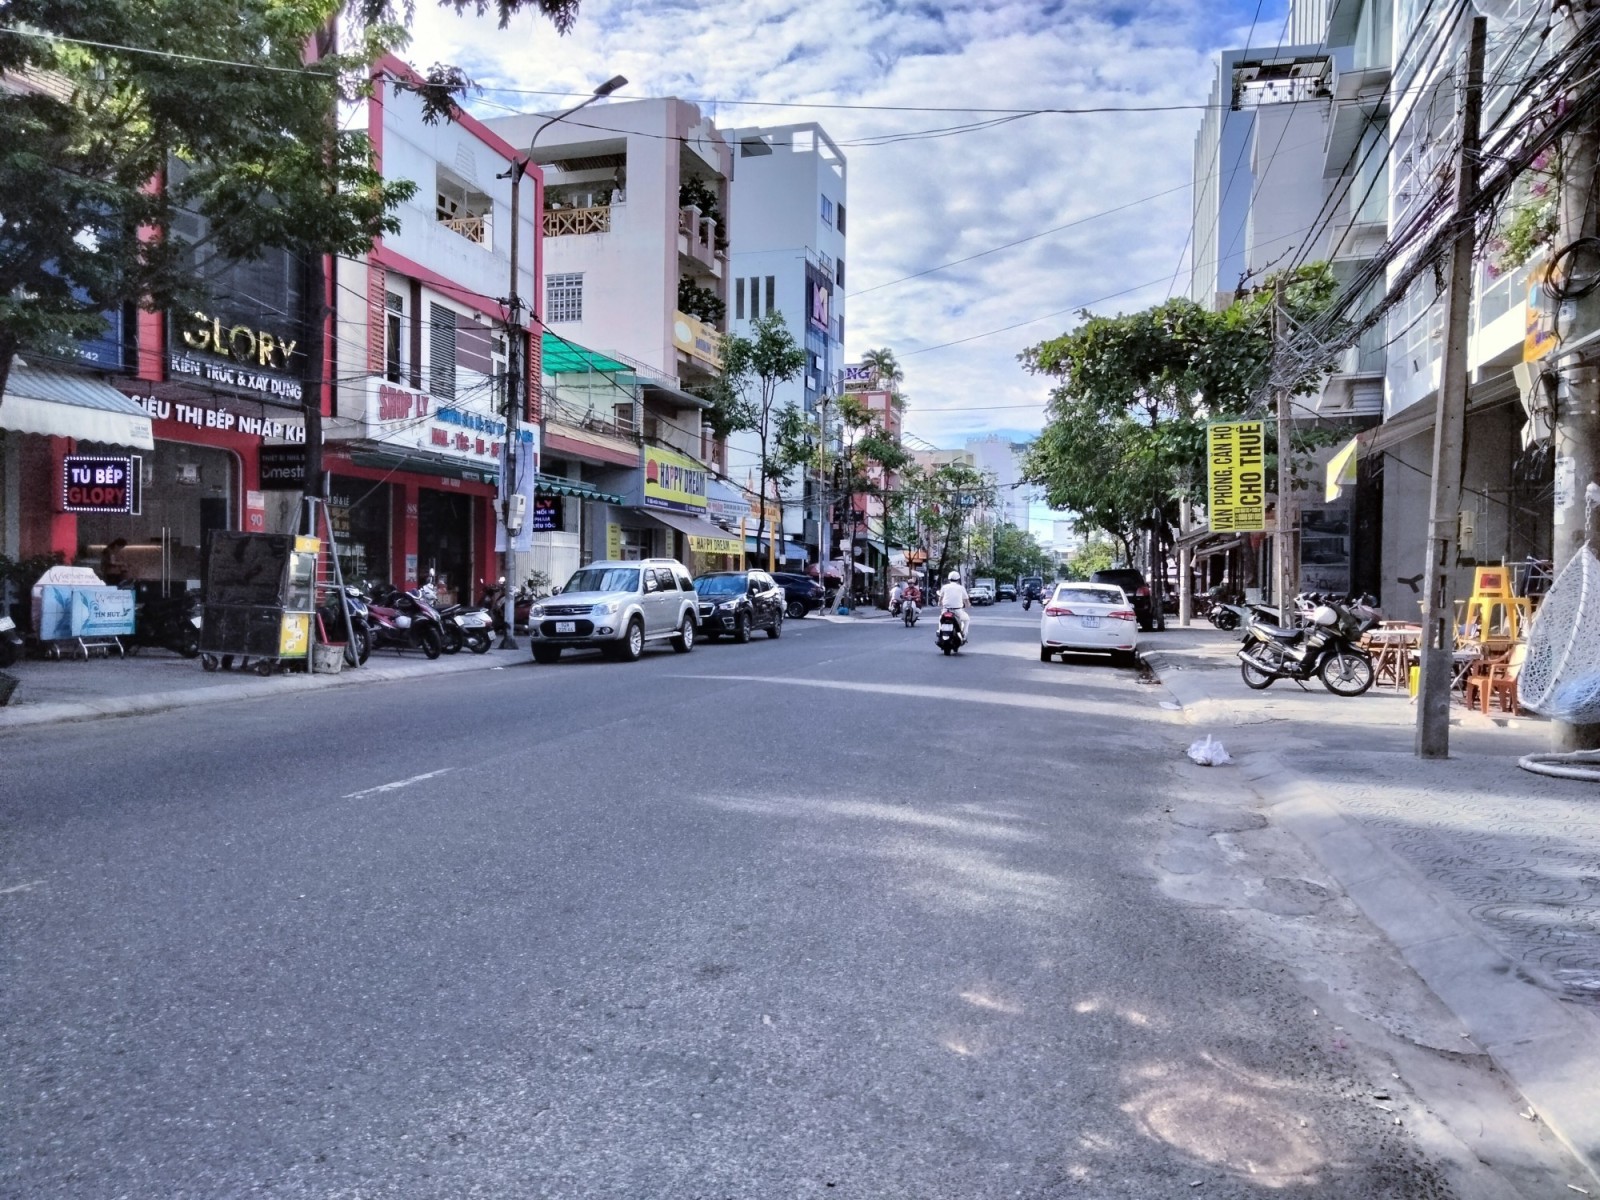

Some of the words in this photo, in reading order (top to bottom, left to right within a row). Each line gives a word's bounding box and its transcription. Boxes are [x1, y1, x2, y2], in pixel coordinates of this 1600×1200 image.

[183, 311, 297, 369] GLORY
[171, 351, 200, 376] KIẾN
[205, 363, 234, 385] TRÚC
[237, 371, 247, 387] &
[247, 374, 269, 392] XÂY
[270, 376, 302, 400] DỰNG
[379, 384, 413, 421] SHOP
[416, 394, 430, 418] LY
[175, 404, 202, 430] THỊ
[205, 407, 235, 431] BẾP
[238, 417, 282, 441] NHẬP
[1209, 425, 1236, 441] HỘ
[1210, 443, 1233, 465] CĂN
[1235, 423, 1262, 467] THUÊ
[71, 465, 91, 484] TỦ
[95, 464, 124, 484] BẾP
[660, 462, 683, 492] HAPPY
[684, 469, 705, 497] DREAM
[1239, 471, 1262, 506] CHO
[68, 487, 125, 504] GLORY
[251, 513, 263, 527] 90
[1210, 508, 1233, 530] VĂN
